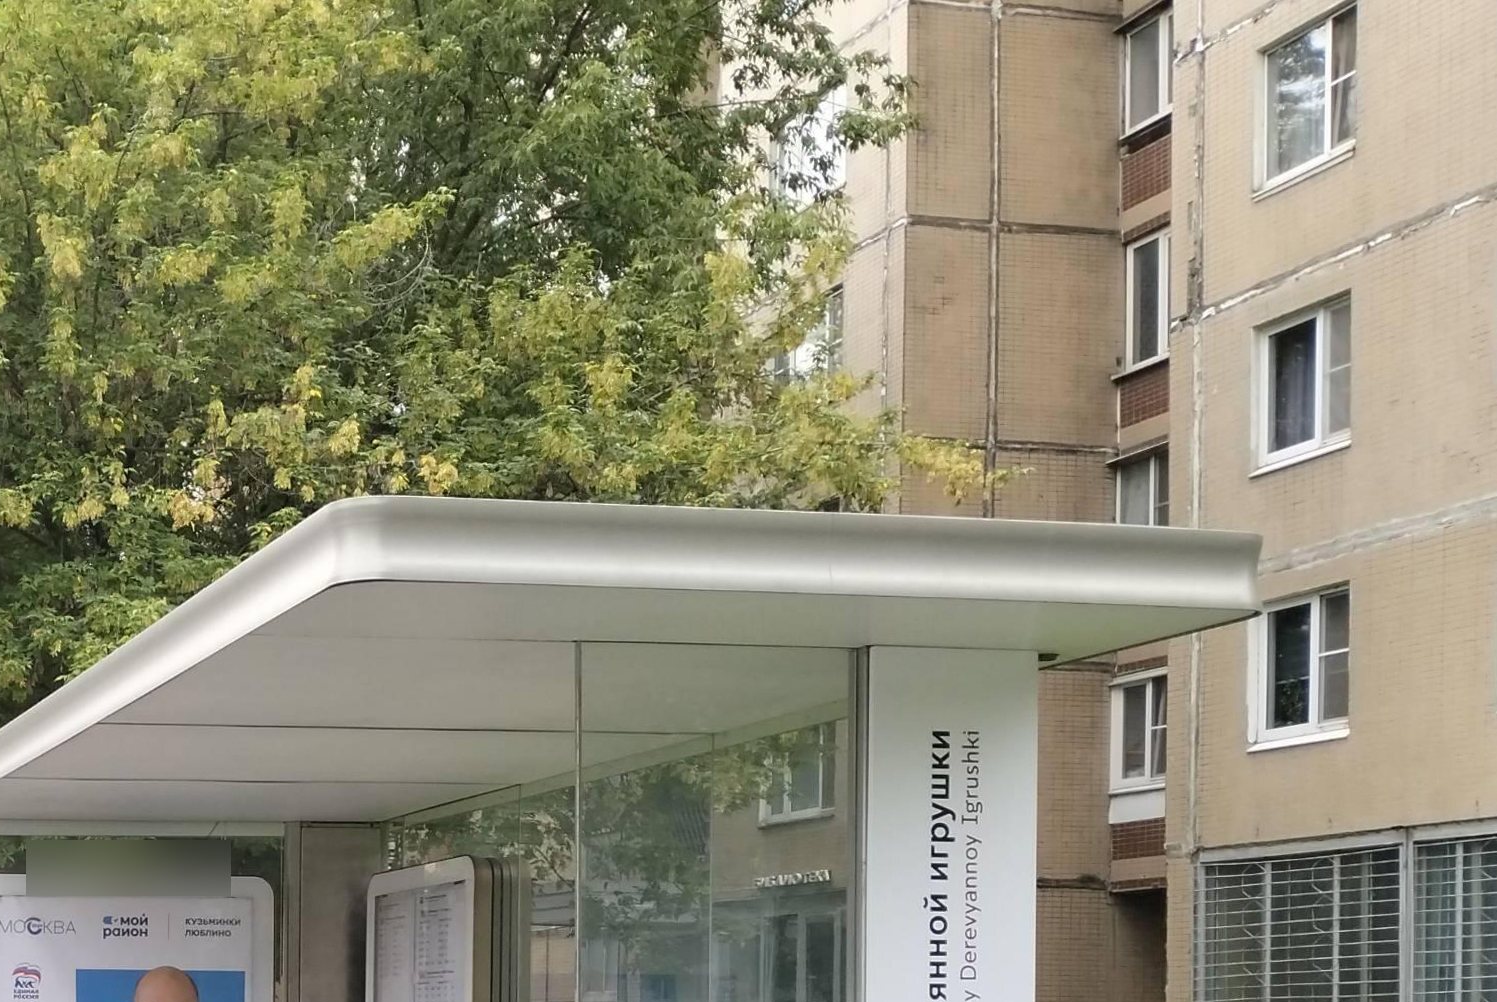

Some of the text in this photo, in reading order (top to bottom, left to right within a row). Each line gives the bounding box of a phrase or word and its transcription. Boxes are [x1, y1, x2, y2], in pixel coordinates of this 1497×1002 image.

[929, 730, 956, 881] игрушки
[961, 730, 983, 825] Igrushki
[185, 929, 232, 937] ЛЮБЛИНО
[960, 834, 982, 980] Derevyannoy
